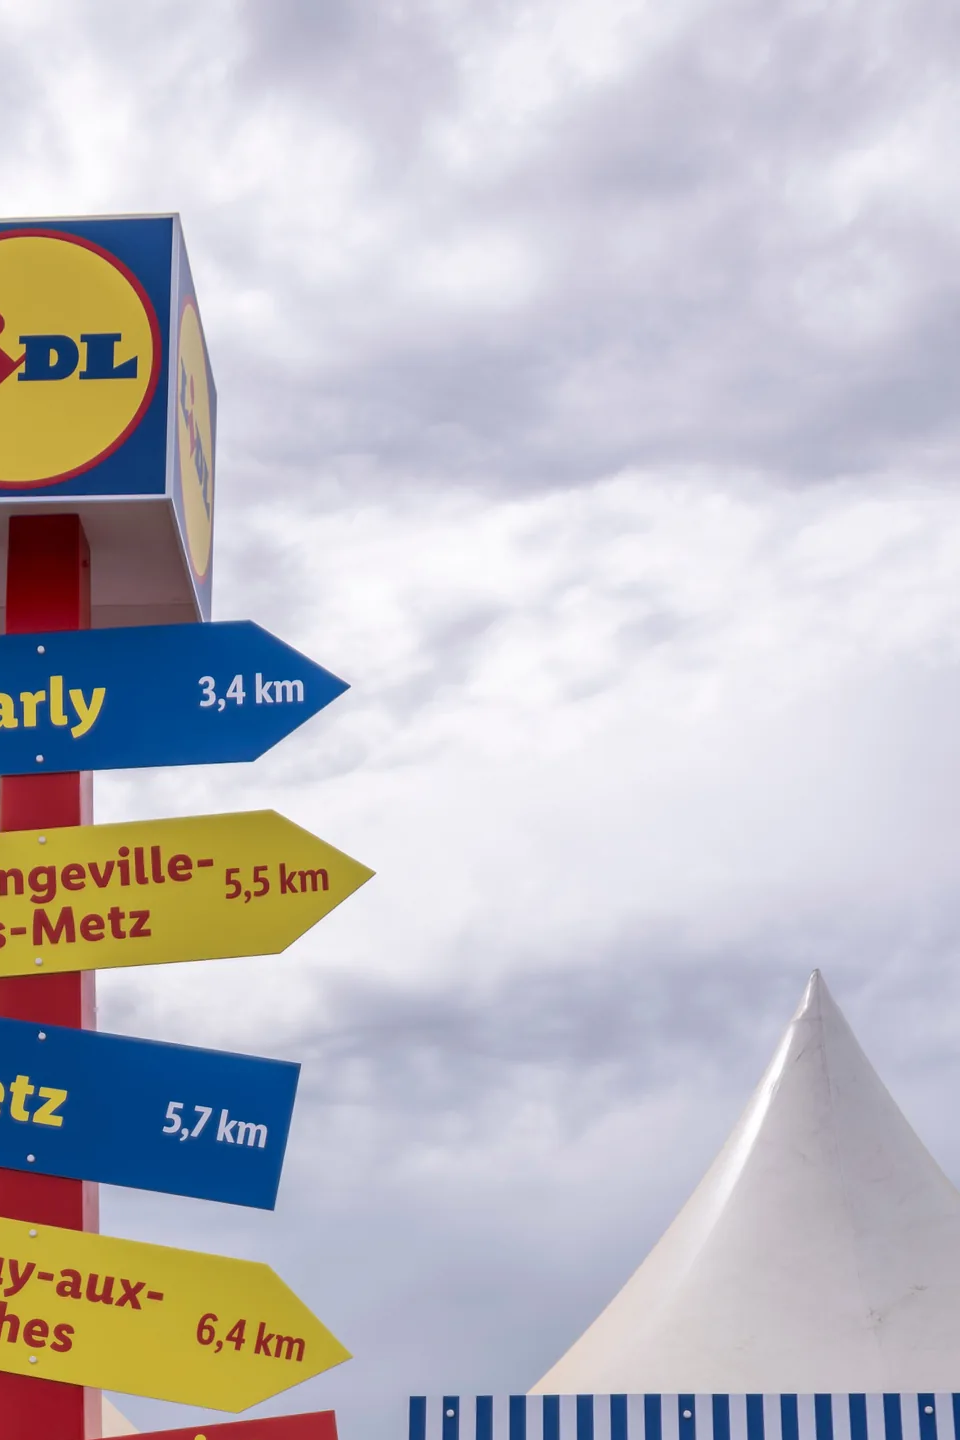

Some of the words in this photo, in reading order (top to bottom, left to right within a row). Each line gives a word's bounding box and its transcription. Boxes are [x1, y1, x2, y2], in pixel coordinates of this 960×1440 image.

[198, 674, 246, 712] 3,4
[255, 672, 304, 704] km
[225, 865, 270, 904] 5,5
[279, 863, 329, 894] km
[162, 1101, 213, 1141] 5,7
[216, 1109, 268, 1148] km
[196, 1313, 246, 1353] 6,4
[254, 1321, 305, 1362] km
